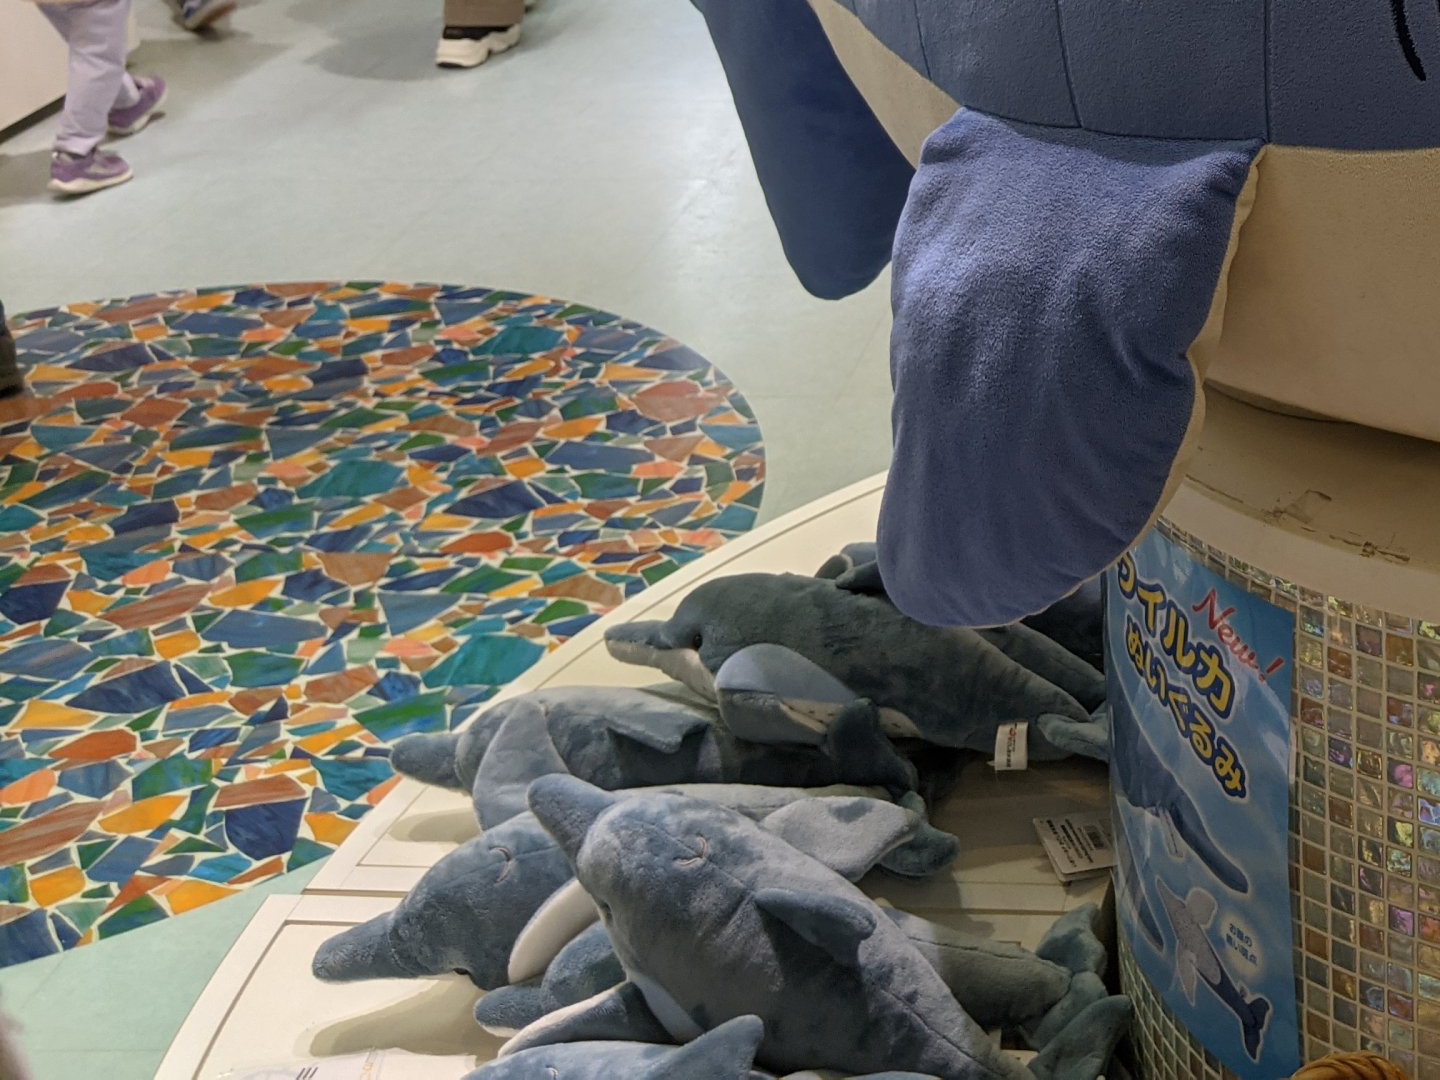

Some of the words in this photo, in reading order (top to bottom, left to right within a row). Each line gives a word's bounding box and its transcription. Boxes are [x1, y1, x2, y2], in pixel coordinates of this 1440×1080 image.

[1191, 587, 1285, 684] New!
[1126, 621, 1246, 798] ぬいぐるみ
